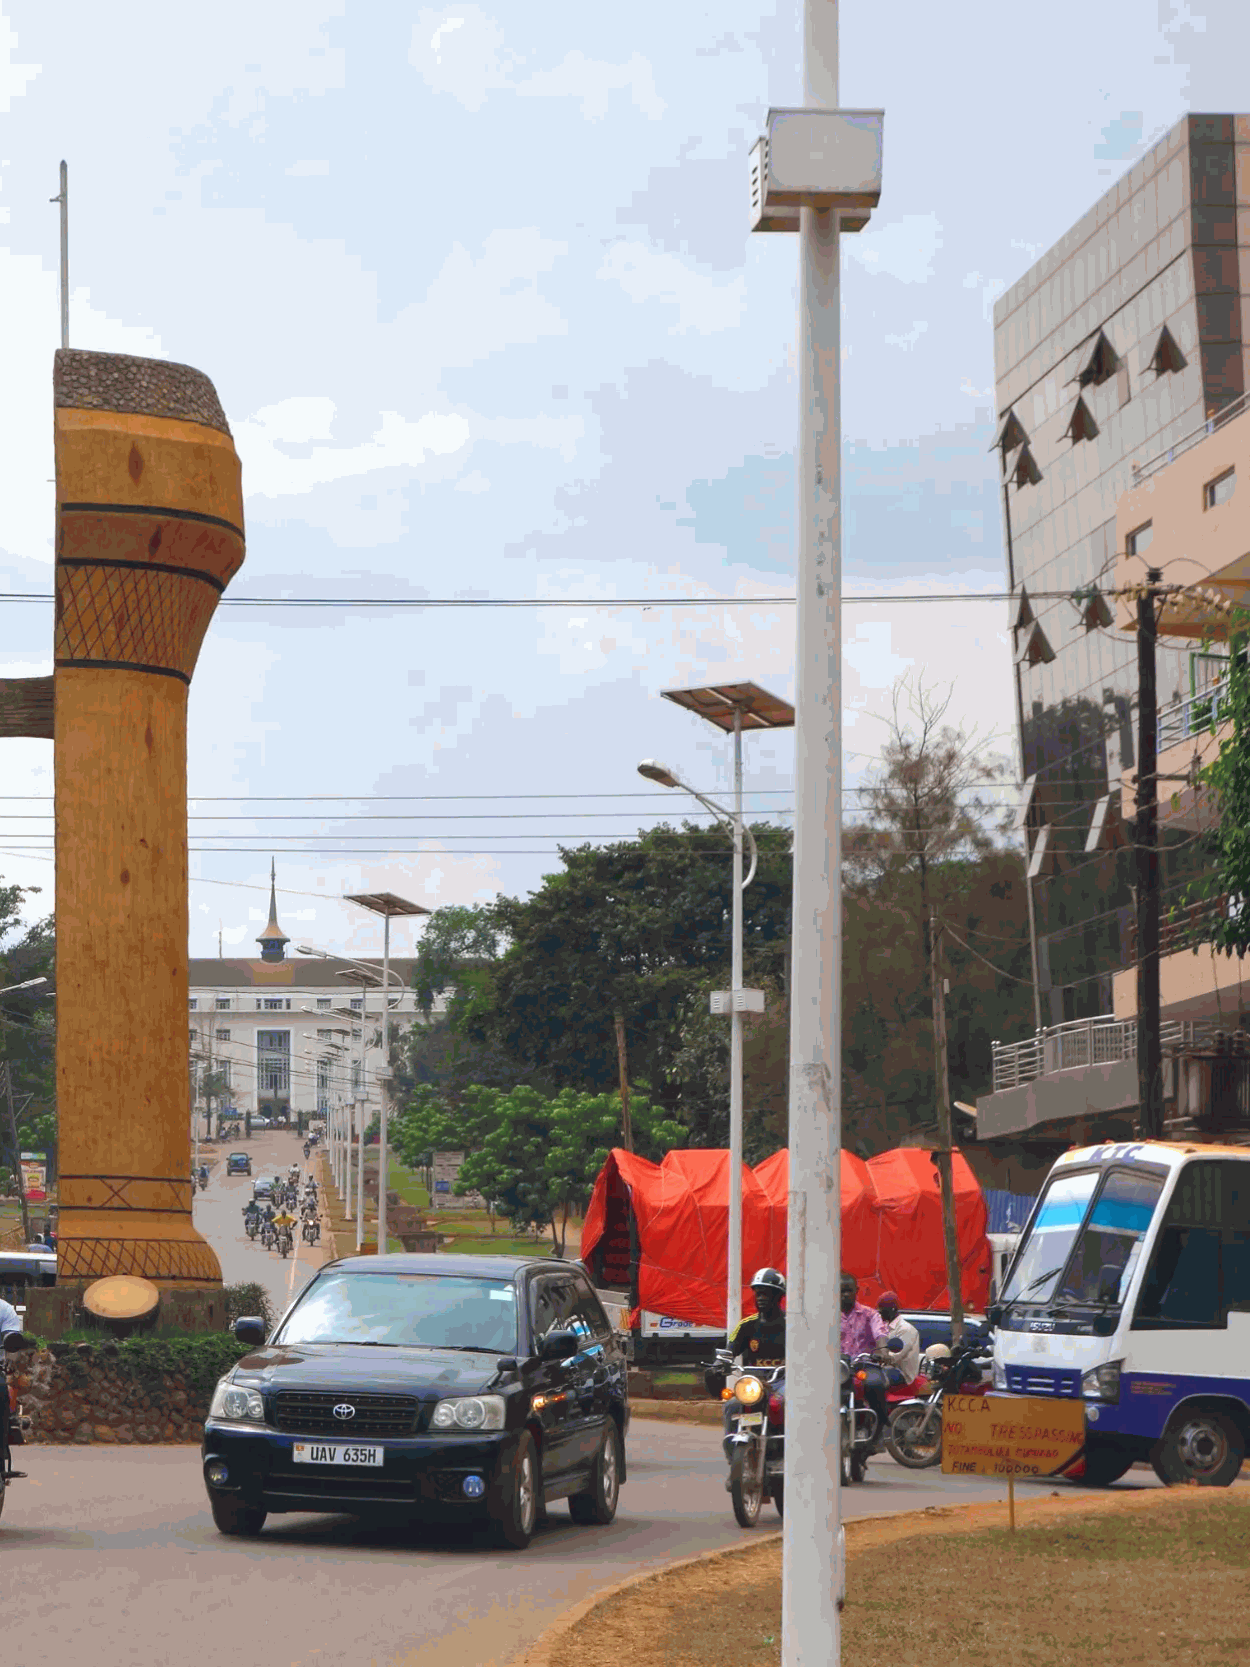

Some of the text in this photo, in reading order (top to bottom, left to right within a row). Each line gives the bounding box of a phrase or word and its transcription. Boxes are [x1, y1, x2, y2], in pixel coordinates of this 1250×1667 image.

[1029, 1321, 1056, 1332] ISUZU
[944, 1422, 963, 1435] NO
[311, 1446, 377, 1464] UAV 635H
[951, 1460, 978, 1473] FINE
